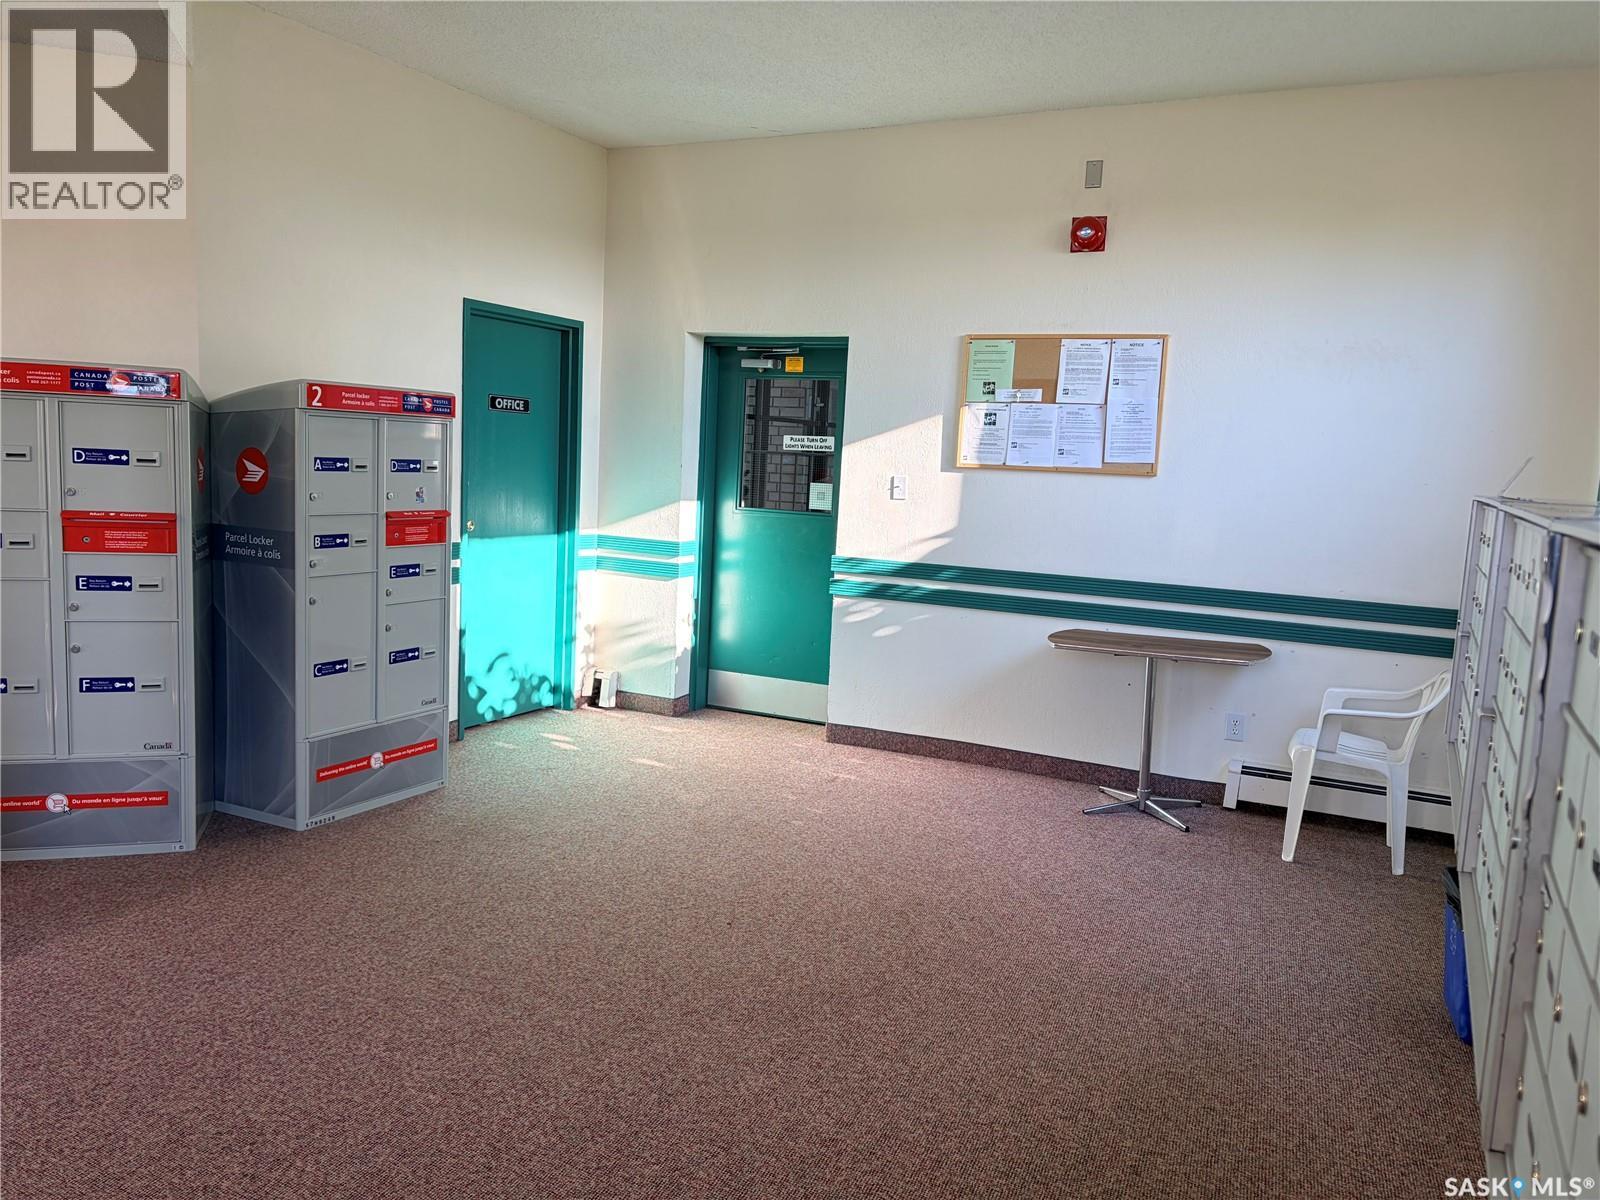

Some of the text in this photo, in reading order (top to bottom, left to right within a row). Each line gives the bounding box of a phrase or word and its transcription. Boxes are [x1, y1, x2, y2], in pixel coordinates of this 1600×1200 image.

[312, 386, 322, 406] 2
[496, 398, 524, 410] OFFICE
[74, 450, 85, 462] D
[314, 459, 322, 470] A
[392, 461, 398, 470] D
[225, 531, 274, 546] Parcel Locker
[315, 536, 320, 548] B
[226, 544, 256, 556] Armoire
[264, 549, 280, 560] colis
[392, 568, 396, 578] E
[80, 578, 87, 589] E
[390, 652, 396, 663] F
[315, 664, 322, 676] C
[82, 680, 90, 691] F
